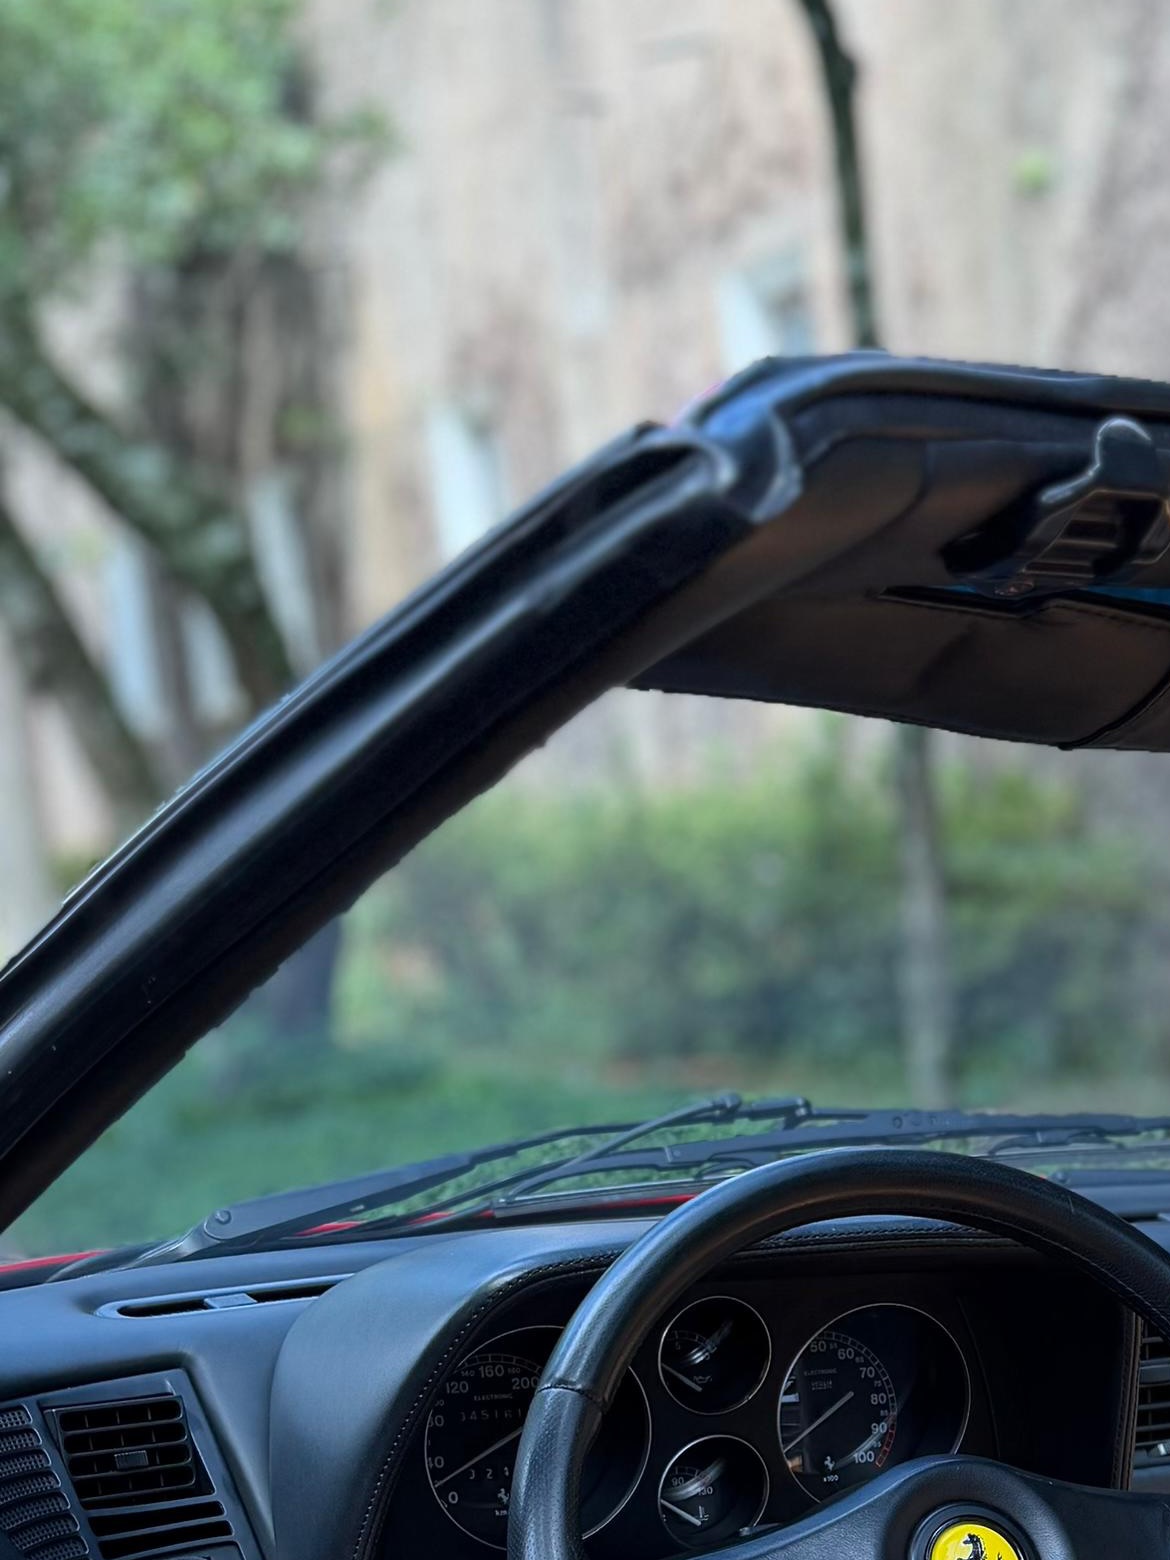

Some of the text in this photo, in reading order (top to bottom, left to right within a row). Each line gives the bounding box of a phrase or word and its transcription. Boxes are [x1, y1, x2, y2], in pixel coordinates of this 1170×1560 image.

[837, 1348, 855, 1361] 60
[478, 1364, 505, 1379] 160
[859, 1366, 876, 1379] 70
[446, 1381, 469, 1394] 120
[511, 1376, 540, 1391] 200
[870, 1392, 887, 1406] 80
[870, 1422, 888, 1435] 90
[853, 1451, 875, 1464] 100
[447, 1491, 459, 1505] 0
